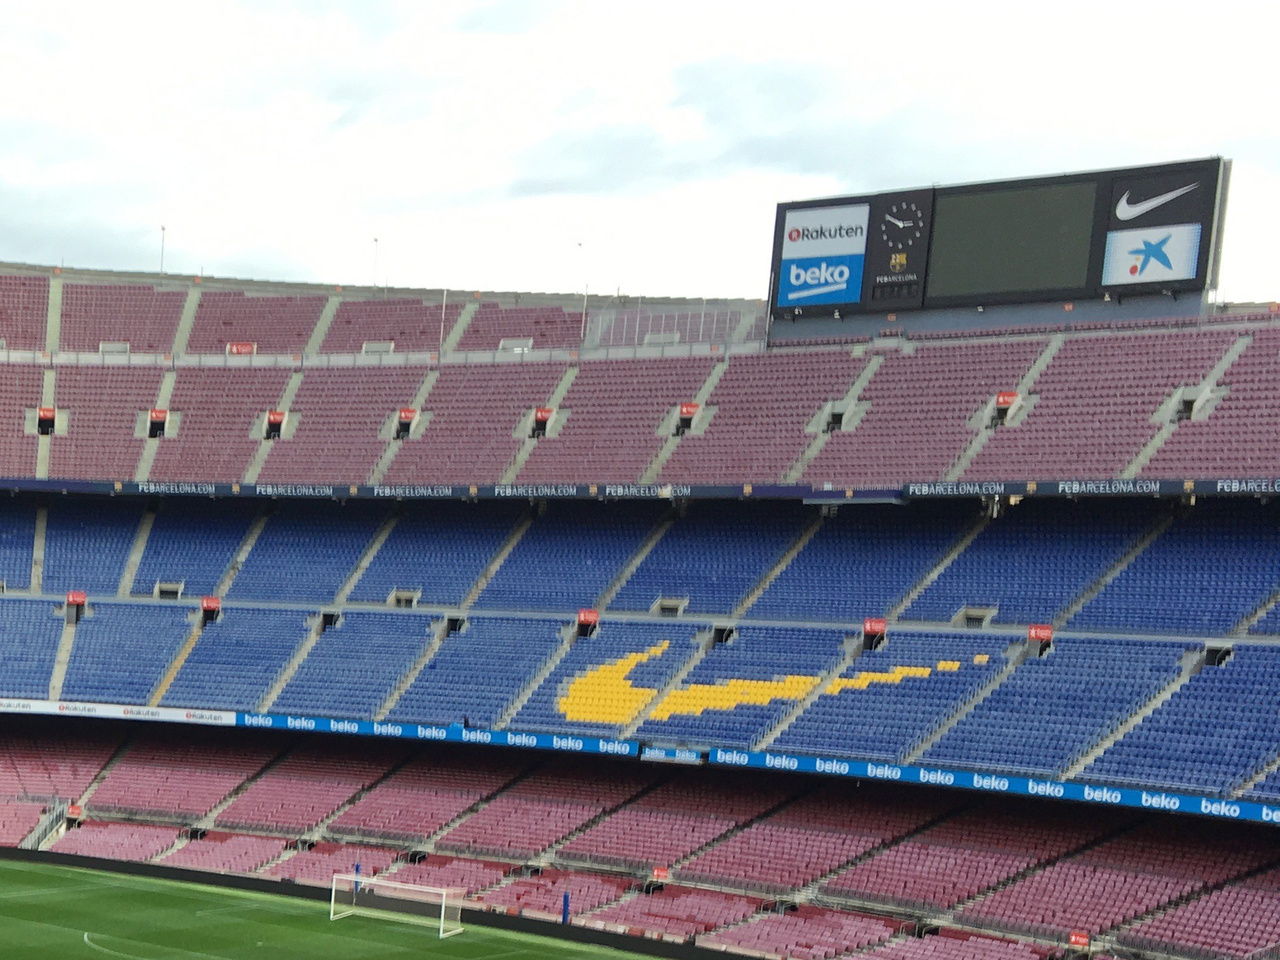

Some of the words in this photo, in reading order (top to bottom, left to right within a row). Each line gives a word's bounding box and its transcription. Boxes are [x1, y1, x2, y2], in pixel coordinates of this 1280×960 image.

[801, 225, 864, 241] Rakuten
[790, 262, 850, 286] beko
[244, 713, 272, 727] beko
[287, 716, 315, 730] beko
[330, 719, 359, 734] beko
[373, 722, 402, 737] beko
[417, 725, 446, 740] beko
[462, 728, 491, 744] beko
[507, 732, 537, 748] beko
[553, 735, 583, 751] beko
[599, 739, 630, 755] beko
[717, 749, 748, 766] beko
[765, 753, 798, 770] beko
[816, 758, 849, 775] beko
[867, 763, 901, 780] beko
[919, 767, 954, 785] beko
[973, 773, 1009, 791] beko
[1028, 779, 1064, 797] beko
[1084, 785, 1121, 804] beko
[1141, 791, 1180, 810] beko
[1200, 797, 1240, 817] beko
